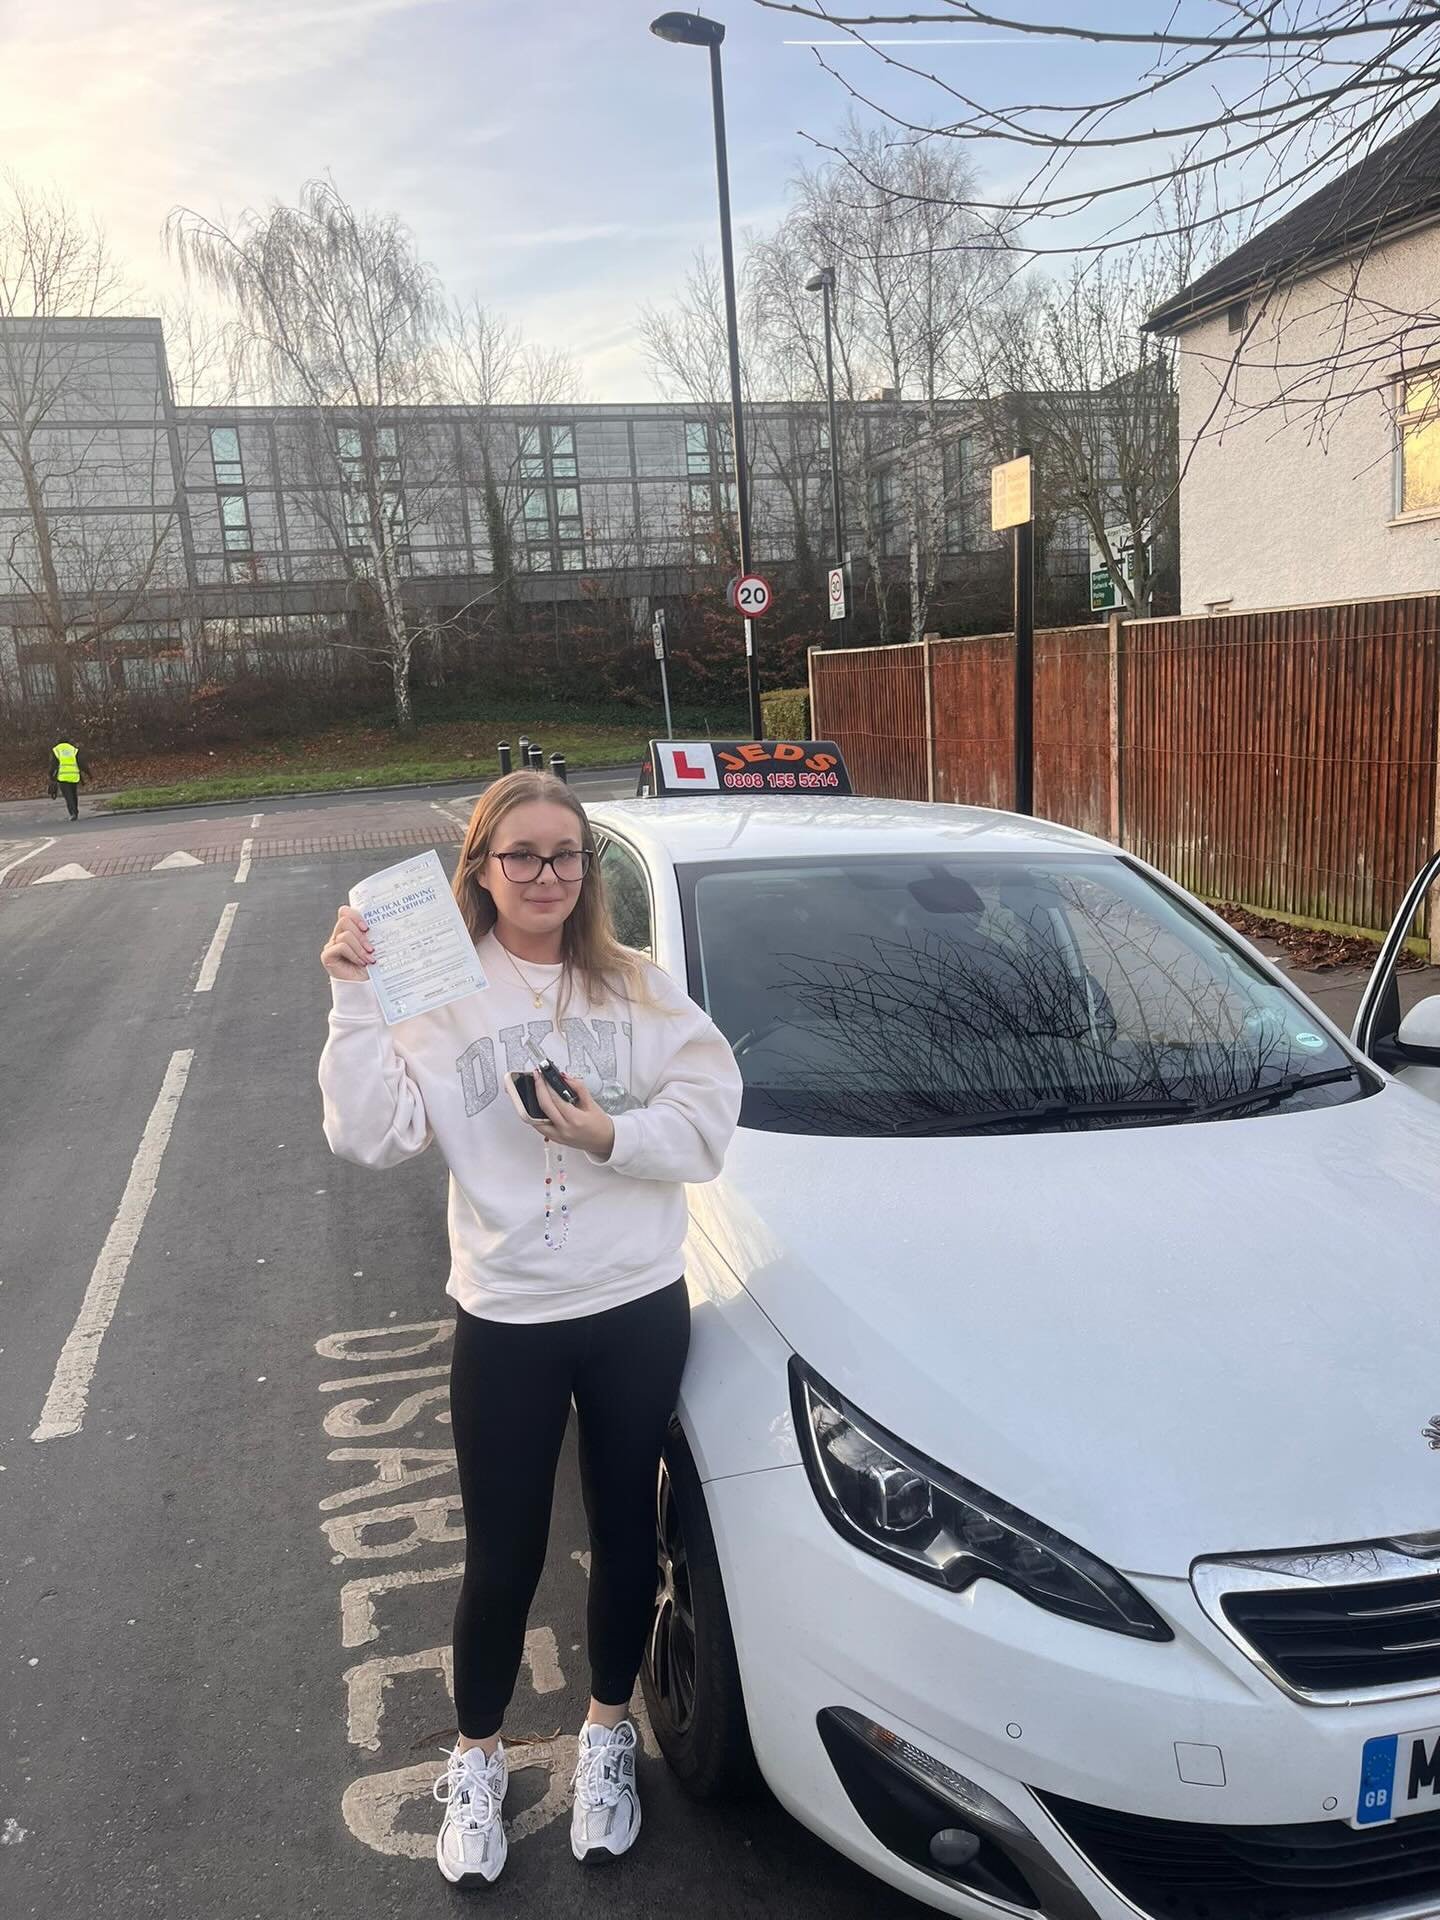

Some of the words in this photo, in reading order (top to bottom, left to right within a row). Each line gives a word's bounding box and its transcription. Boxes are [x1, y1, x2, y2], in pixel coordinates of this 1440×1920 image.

[740, 587, 766, 604] 20
[672, 750, 706, 779] L
[718, 743, 837, 772] JEDS
[724, 772, 764, 789] 0808
[767, 772, 796, 788] 155
[799, 771, 839, 788] 5214
[363, 899, 402, 920] PRACTICAL
[402, 886, 435, 904] DRIVING
[367, 915, 382, 927] TEST
[456, 1017, 632, 1118] DKN
[1365, 1788, 1388, 1808] GB
